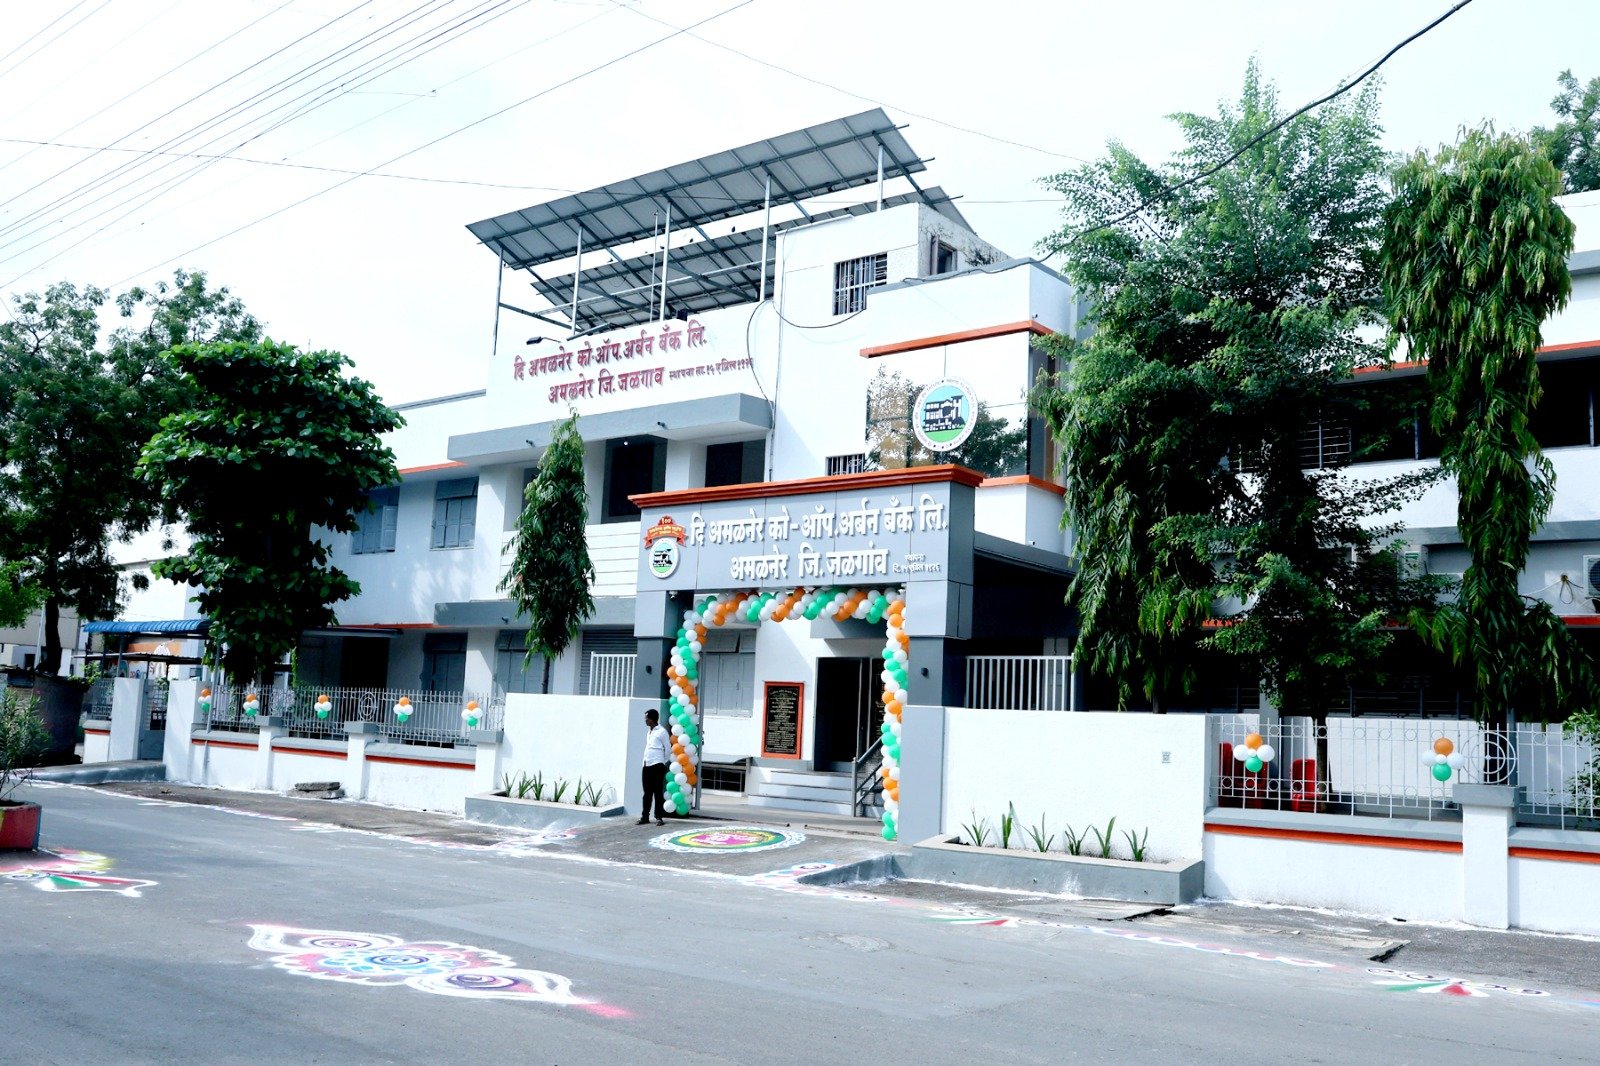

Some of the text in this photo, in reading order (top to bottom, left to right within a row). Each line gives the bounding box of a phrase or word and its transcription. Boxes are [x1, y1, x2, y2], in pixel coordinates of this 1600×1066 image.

[514, 355, 526, 380] दि
[528, 345, 574, 377] अमळनेर
[548, 373, 595, 403] अमळनेर
[690, 511, 706, 547] दि
[708, 507, 766, 544] अमळनेर
[883, 496, 915, 533] बँक
[918, 493, 948, 531] लि.
[730, 544, 789, 580] अमळनेर
